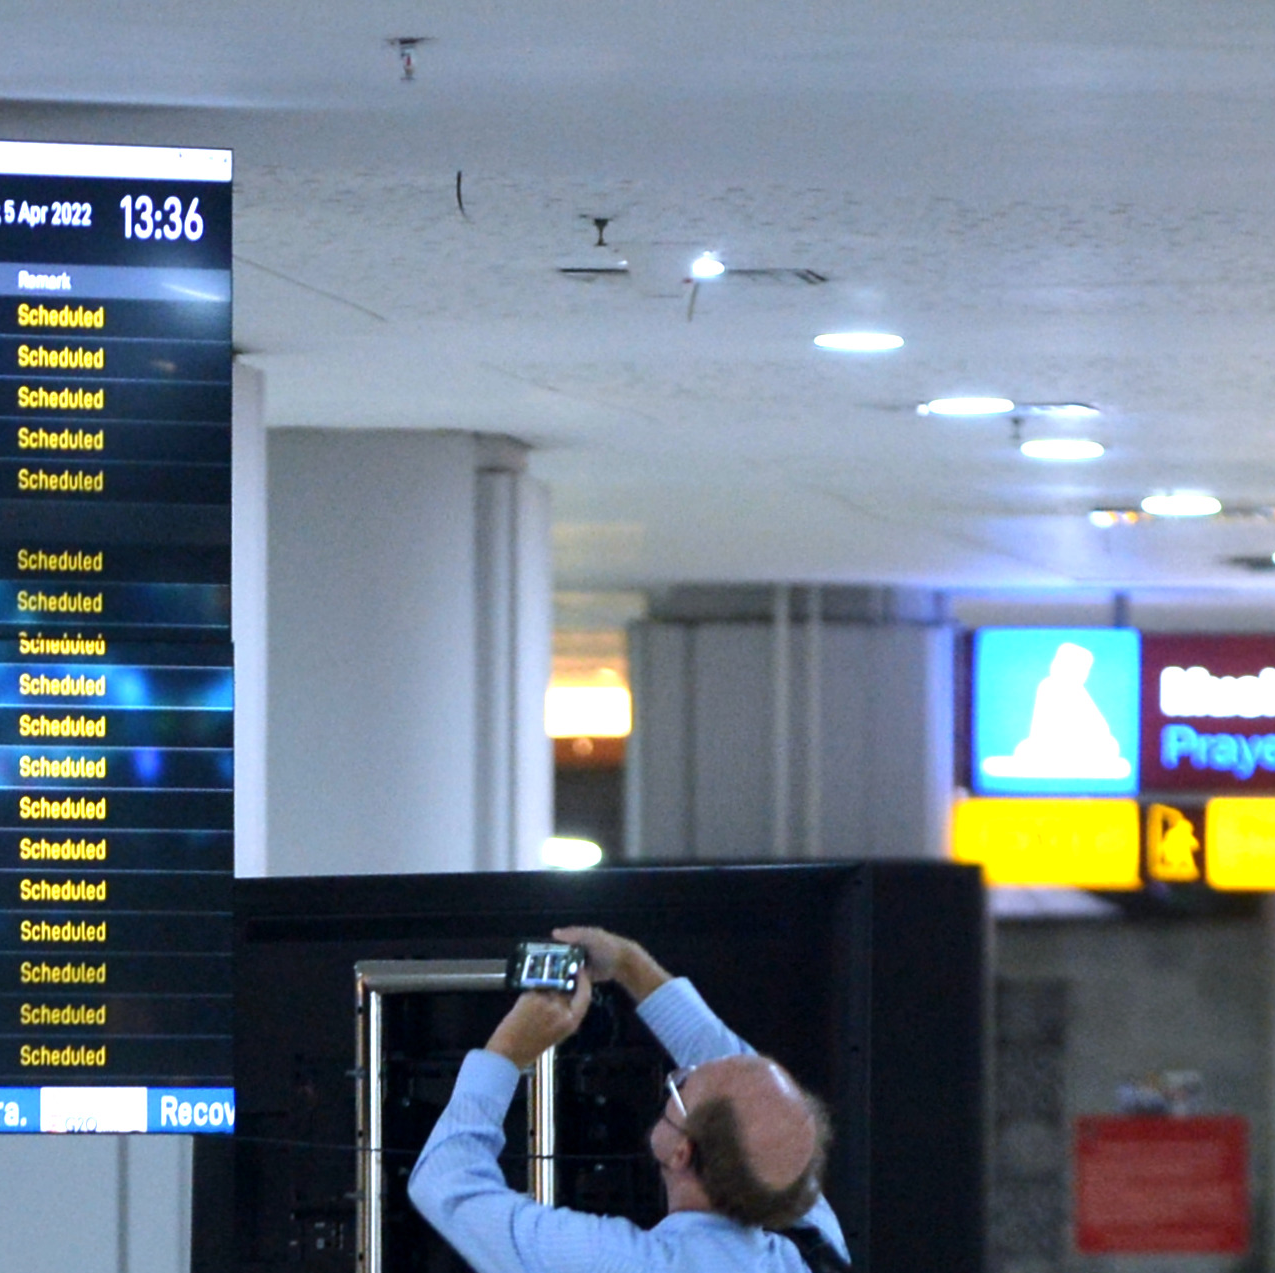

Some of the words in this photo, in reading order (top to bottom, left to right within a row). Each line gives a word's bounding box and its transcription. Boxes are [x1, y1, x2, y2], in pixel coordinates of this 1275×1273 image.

[3, 199, 16, 224] 5
[17, 200, 49, 228] Apr
[51, 201, 92, 227] 2022
[119, 194, 204, 241] 13:36
[17, 303, 105, 329] Scheduled
[17, 344, 105, 370] Scheduled
[17, 385, 104, 410] Scheduled
[17, 426, 104, 451] Scheduled
[17, 468, 104, 492] Scheduled
[17, 548, 103, 572] Scheduled
[17, 590, 103, 613] Scheduled
[19, 795, 107, 820] Scheduled
[19, 878, 107, 901] Scheduled
[20, 919, 107, 942] Scheduled
[20, 961, 107, 984] Scheduled
[20, 1003, 106, 1025] Scheduled
[20, 1044, 106, 1066] Scheduled
